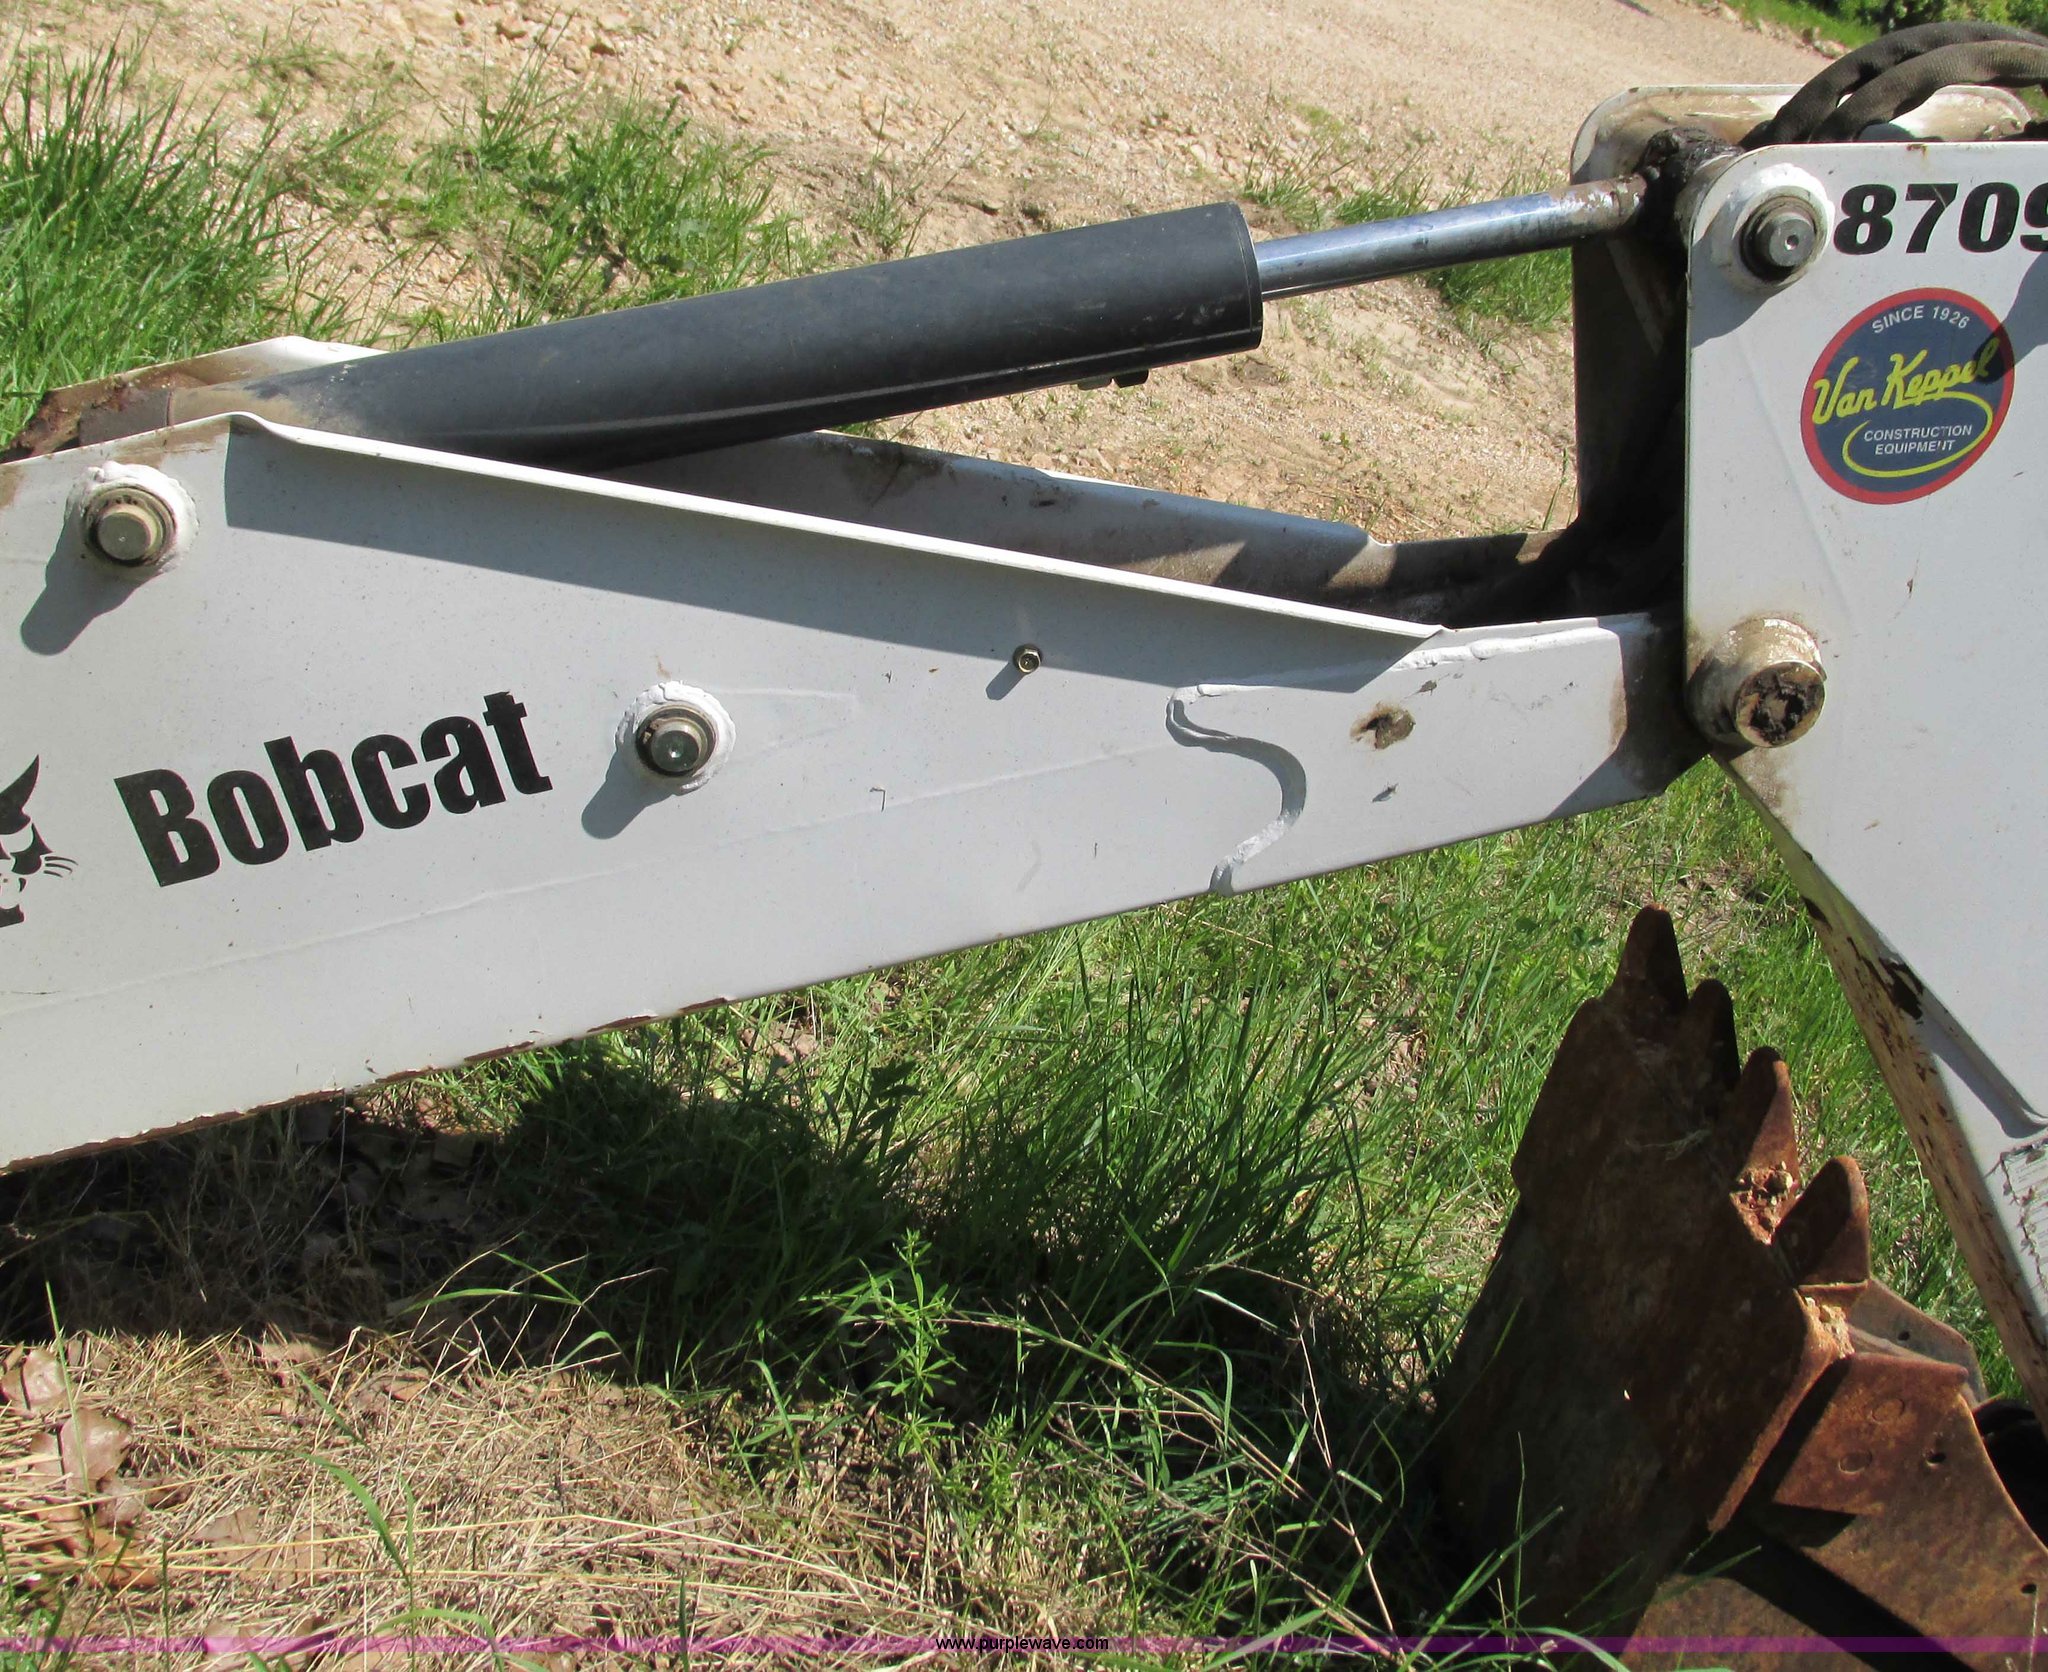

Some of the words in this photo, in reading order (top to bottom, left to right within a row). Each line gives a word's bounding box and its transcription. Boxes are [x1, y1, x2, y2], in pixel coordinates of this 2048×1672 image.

[1872, 305, 1925, 333] SINCE
[1931, 305, 1970, 329] 1926
[1812, 356, 1877, 425] Van
[1881, 336, 2000, 410] Keppel
[1863, 424, 1973, 442] CONSTRUCTION
[1874, 439, 1956, 456] EQUIPMENT
[114, 691, 553, 887] Bobcat
